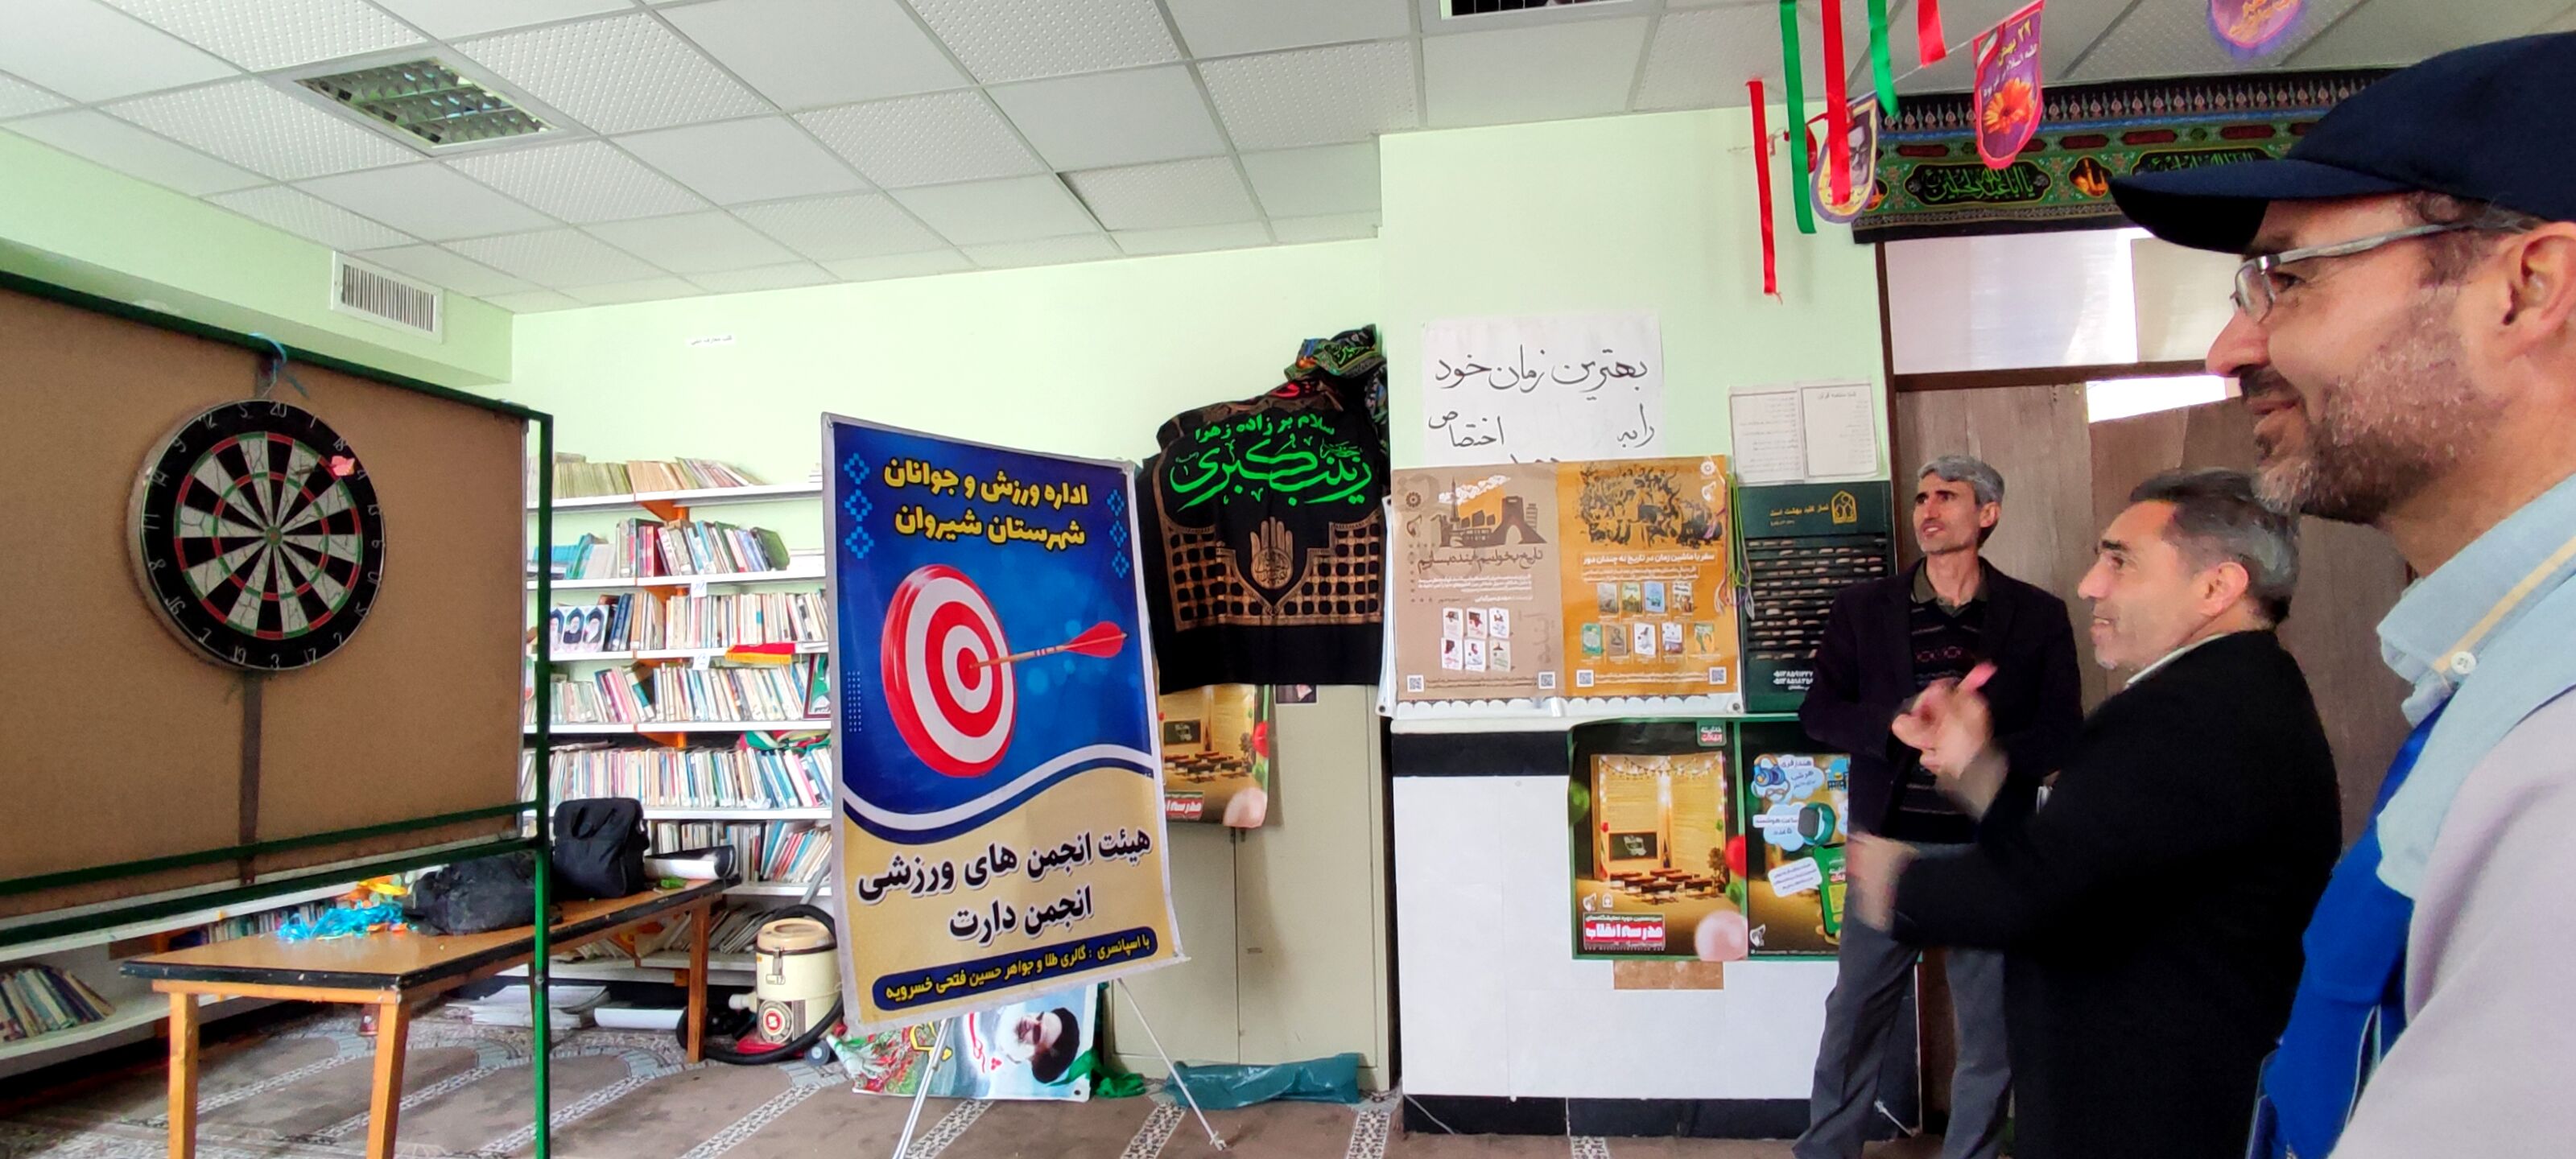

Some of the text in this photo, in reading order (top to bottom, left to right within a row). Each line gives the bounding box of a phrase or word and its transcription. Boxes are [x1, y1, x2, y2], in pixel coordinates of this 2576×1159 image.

[1435, 344, 1649, 401] بهترین زمان خود
[270, 402, 287, 418] 20
[1236, 413, 1274, 436] زاده
[1277, 415, 1294, 434] بر
[1298, 413, 1335, 436] سلام
[1427, 402, 1656, 449] را به اختصاص
[884, 458, 1088, 511] اداره ورزش و جوانان
[1169, 434, 1319, 514] کبری
[895, 505, 1086, 551] شهرستان شیروان
[270, 653, 281, 670] 3
[858, 828, 1152, 902] هیئت انجمن های ورزشی
[949, 885, 1093, 944] انجمن دارت
[1141, 936, 1150, 951] با
[1585, 923, 1663, 941] مدرسه انقلاب
[1060, 944, 1087, 967] گالری
[1096, 936, 1141, 960] اسپانسری
[1003, 959, 1034, 980] جواهر
[1037, 960, 1043, 973] و
[1044, 953, 1058, 967] طلا
[935, 970, 967, 995] فتحی
[969, 966, 1002, 988] حسین
[886, 976, 934, 1002] خسرویه
